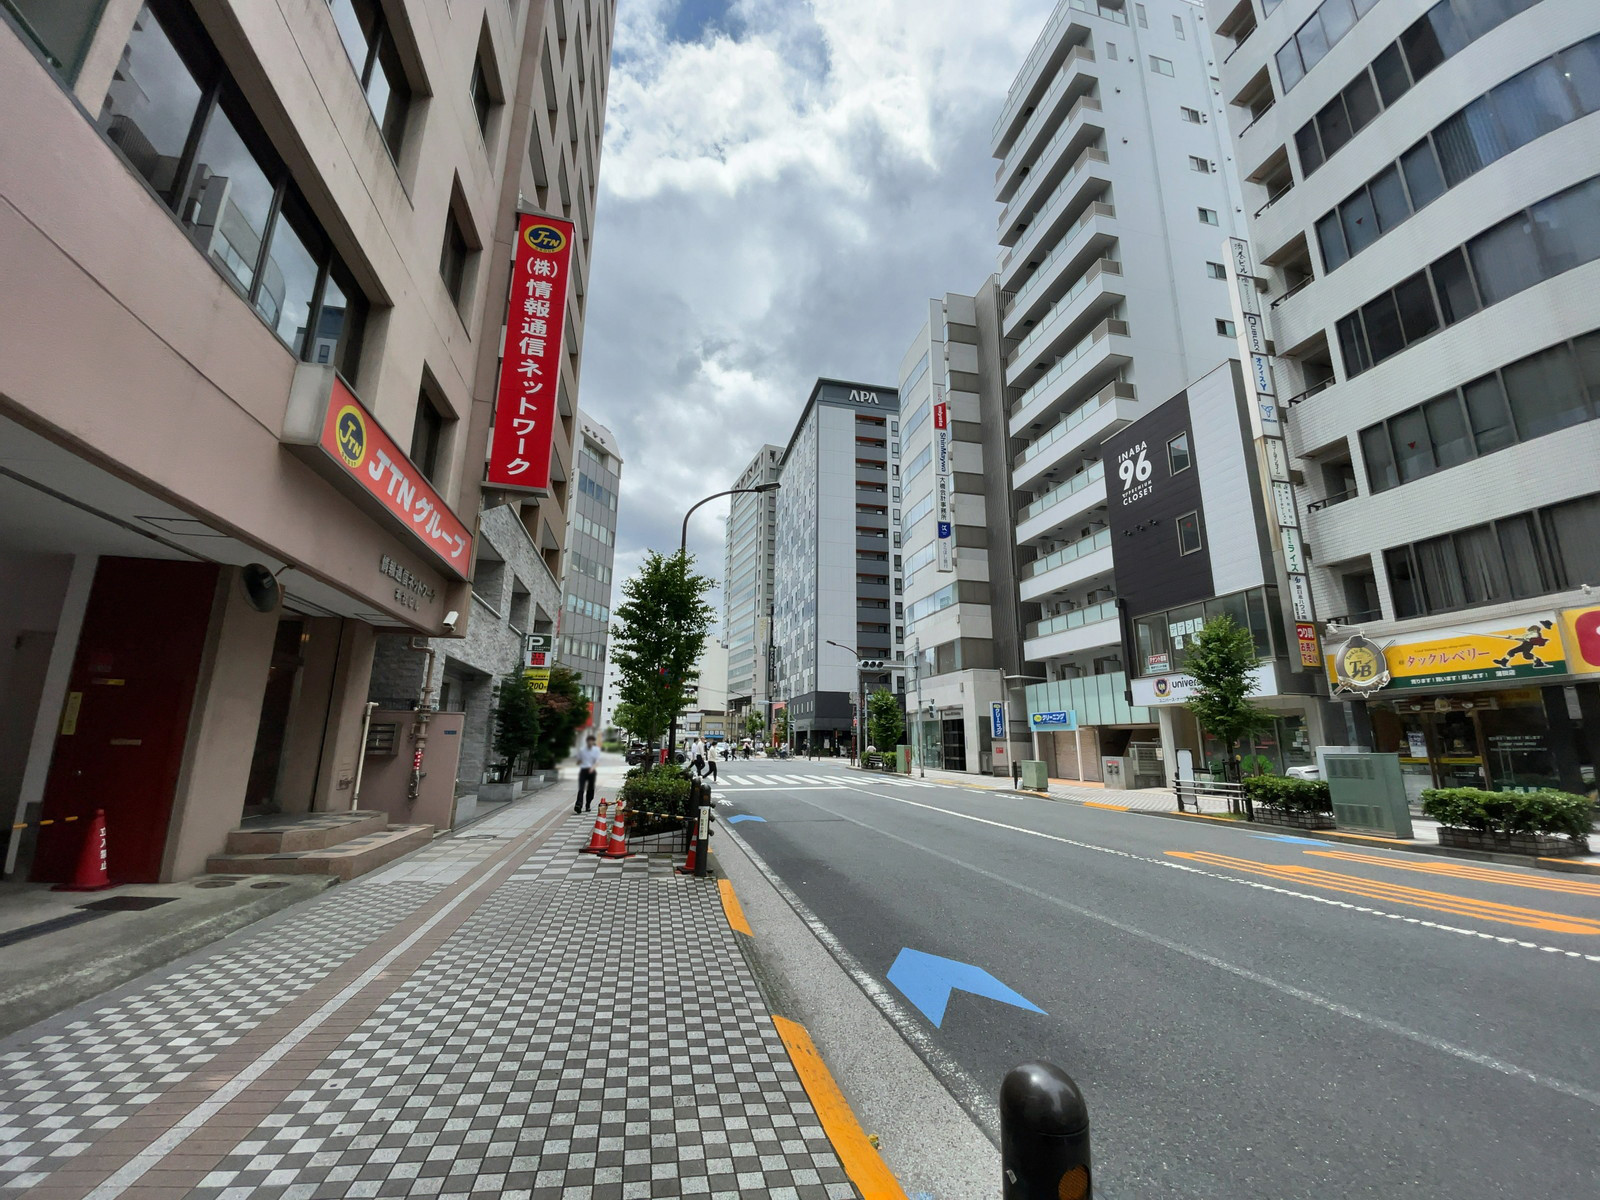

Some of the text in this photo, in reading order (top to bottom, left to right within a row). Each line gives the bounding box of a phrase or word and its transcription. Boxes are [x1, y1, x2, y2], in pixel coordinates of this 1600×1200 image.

[529, 230, 560, 248] JTN
[849, 389, 879, 404] APA
[339, 420, 362, 458] JTN
[1118, 440, 1148, 464] INABA
[1118, 449, 1152, 491] 96
[1122, 485, 1153, 506] CLOSET
[528, 636, 544, 651] P
[1407, 648, 1490, 668] タックルベリー
[1171, 677, 1198, 689] univer
[994, 708, 1003, 736] クリーニング
[1041, 712, 1066, 721] クリーニング
